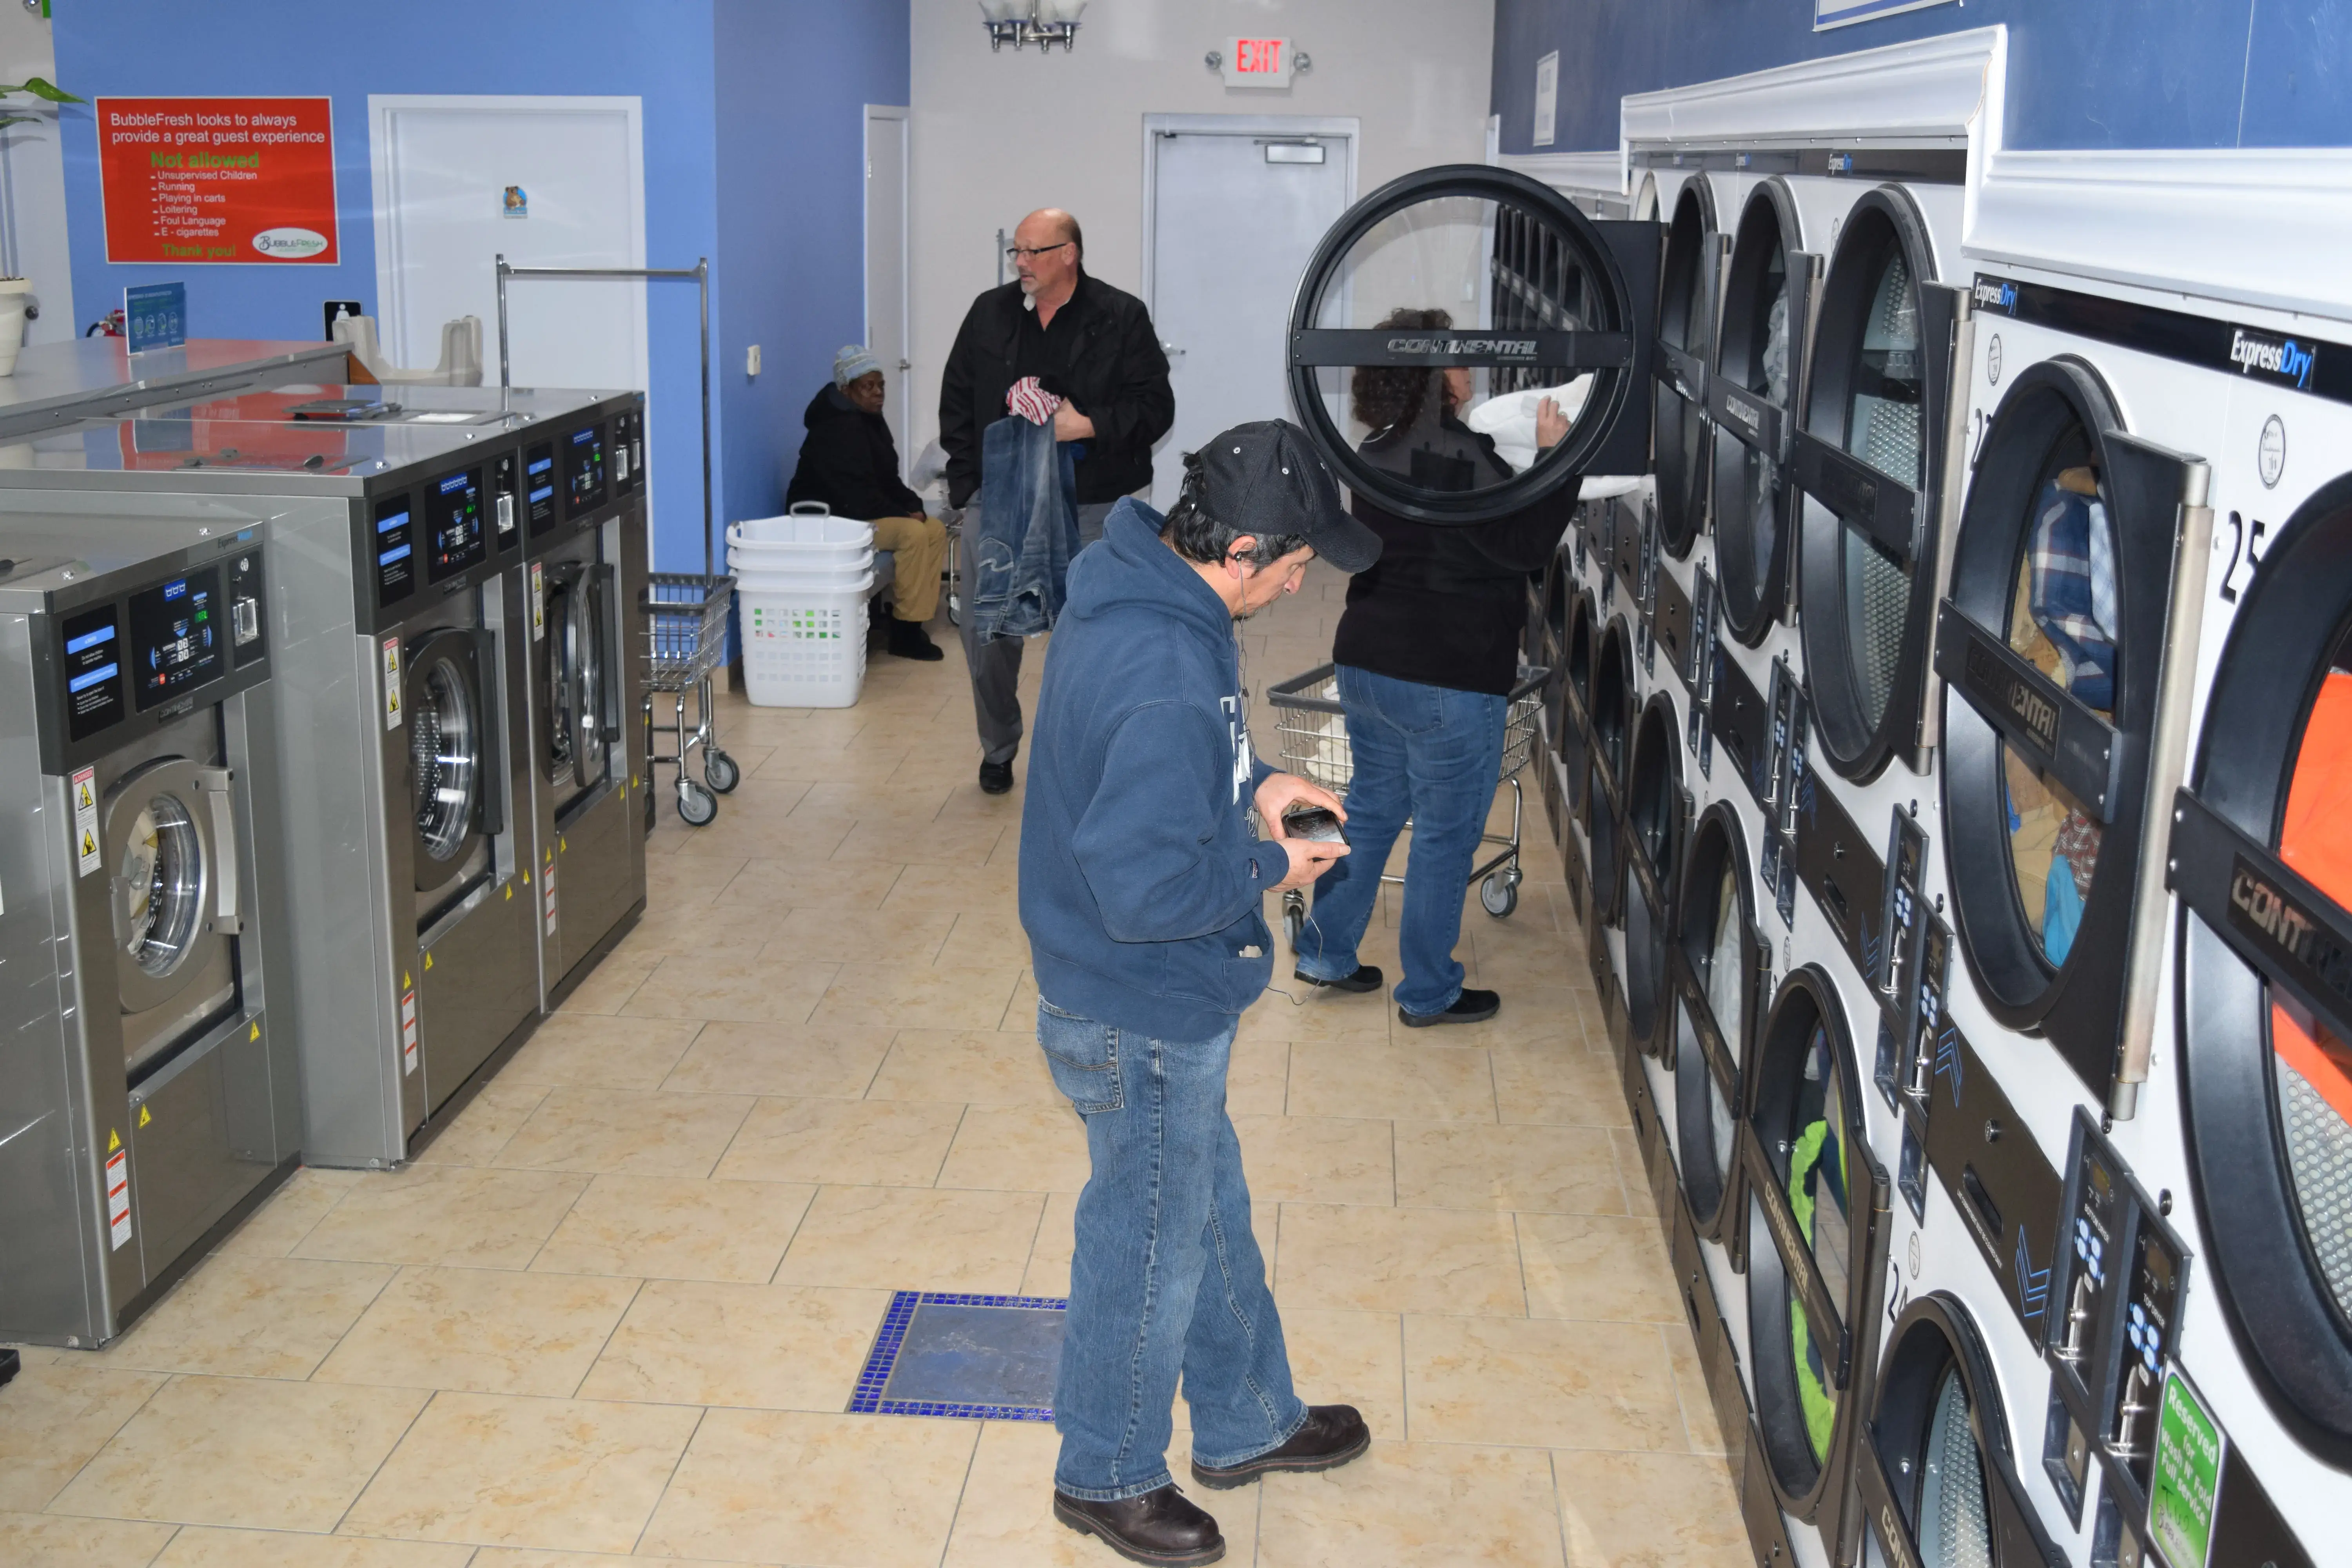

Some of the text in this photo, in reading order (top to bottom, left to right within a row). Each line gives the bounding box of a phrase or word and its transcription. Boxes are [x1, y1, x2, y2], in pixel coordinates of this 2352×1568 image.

[1237, 39, 1282, 73] EXIT
[111, 113, 297, 129] BubbleFresh looks to always
[112, 131, 325, 145] provide a great guest experience
[151, 152, 259, 168] Not allowed
[158, 171, 257, 181] Unsupervised Children
[158, 182, 195, 192] Running
[159, 194, 191, 204] Playing
[194, 194, 201, 202] in
[160, 205, 197, 215] Loitering
[161, 216, 226, 227] Foul Language
[176, 228, 219, 238] cigarettes
[162, 244, 236, 259] Thank you!
[1975, 278, 2016, 314] ExpressDry
[1388, 339, 1537, 354] CONTINENTAL
[2230, 330, 2312, 387] ExpressDry
[1969, 408, 1991, 472] 2
[78, 769, 93, 782] DANGER
[2084, 1203, 2098, 1227] BOTTOM
[2097, 1222, 2109, 1244] DRYER
[1765, 1181, 1808, 1293] CONTINENTAL
[2143, 1292, 2152, 1308] TOP
[2151, 1305, 2165, 1330] DRYER
[2168, 1384, 2216, 1465] Reserved
[2183, 1435, 2195, 1460] for
[2161, 1427, 2182, 1468] Wash
[2194, 1475, 2213, 1511] Fold
[2161, 1451, 2206, 1527] Full service
